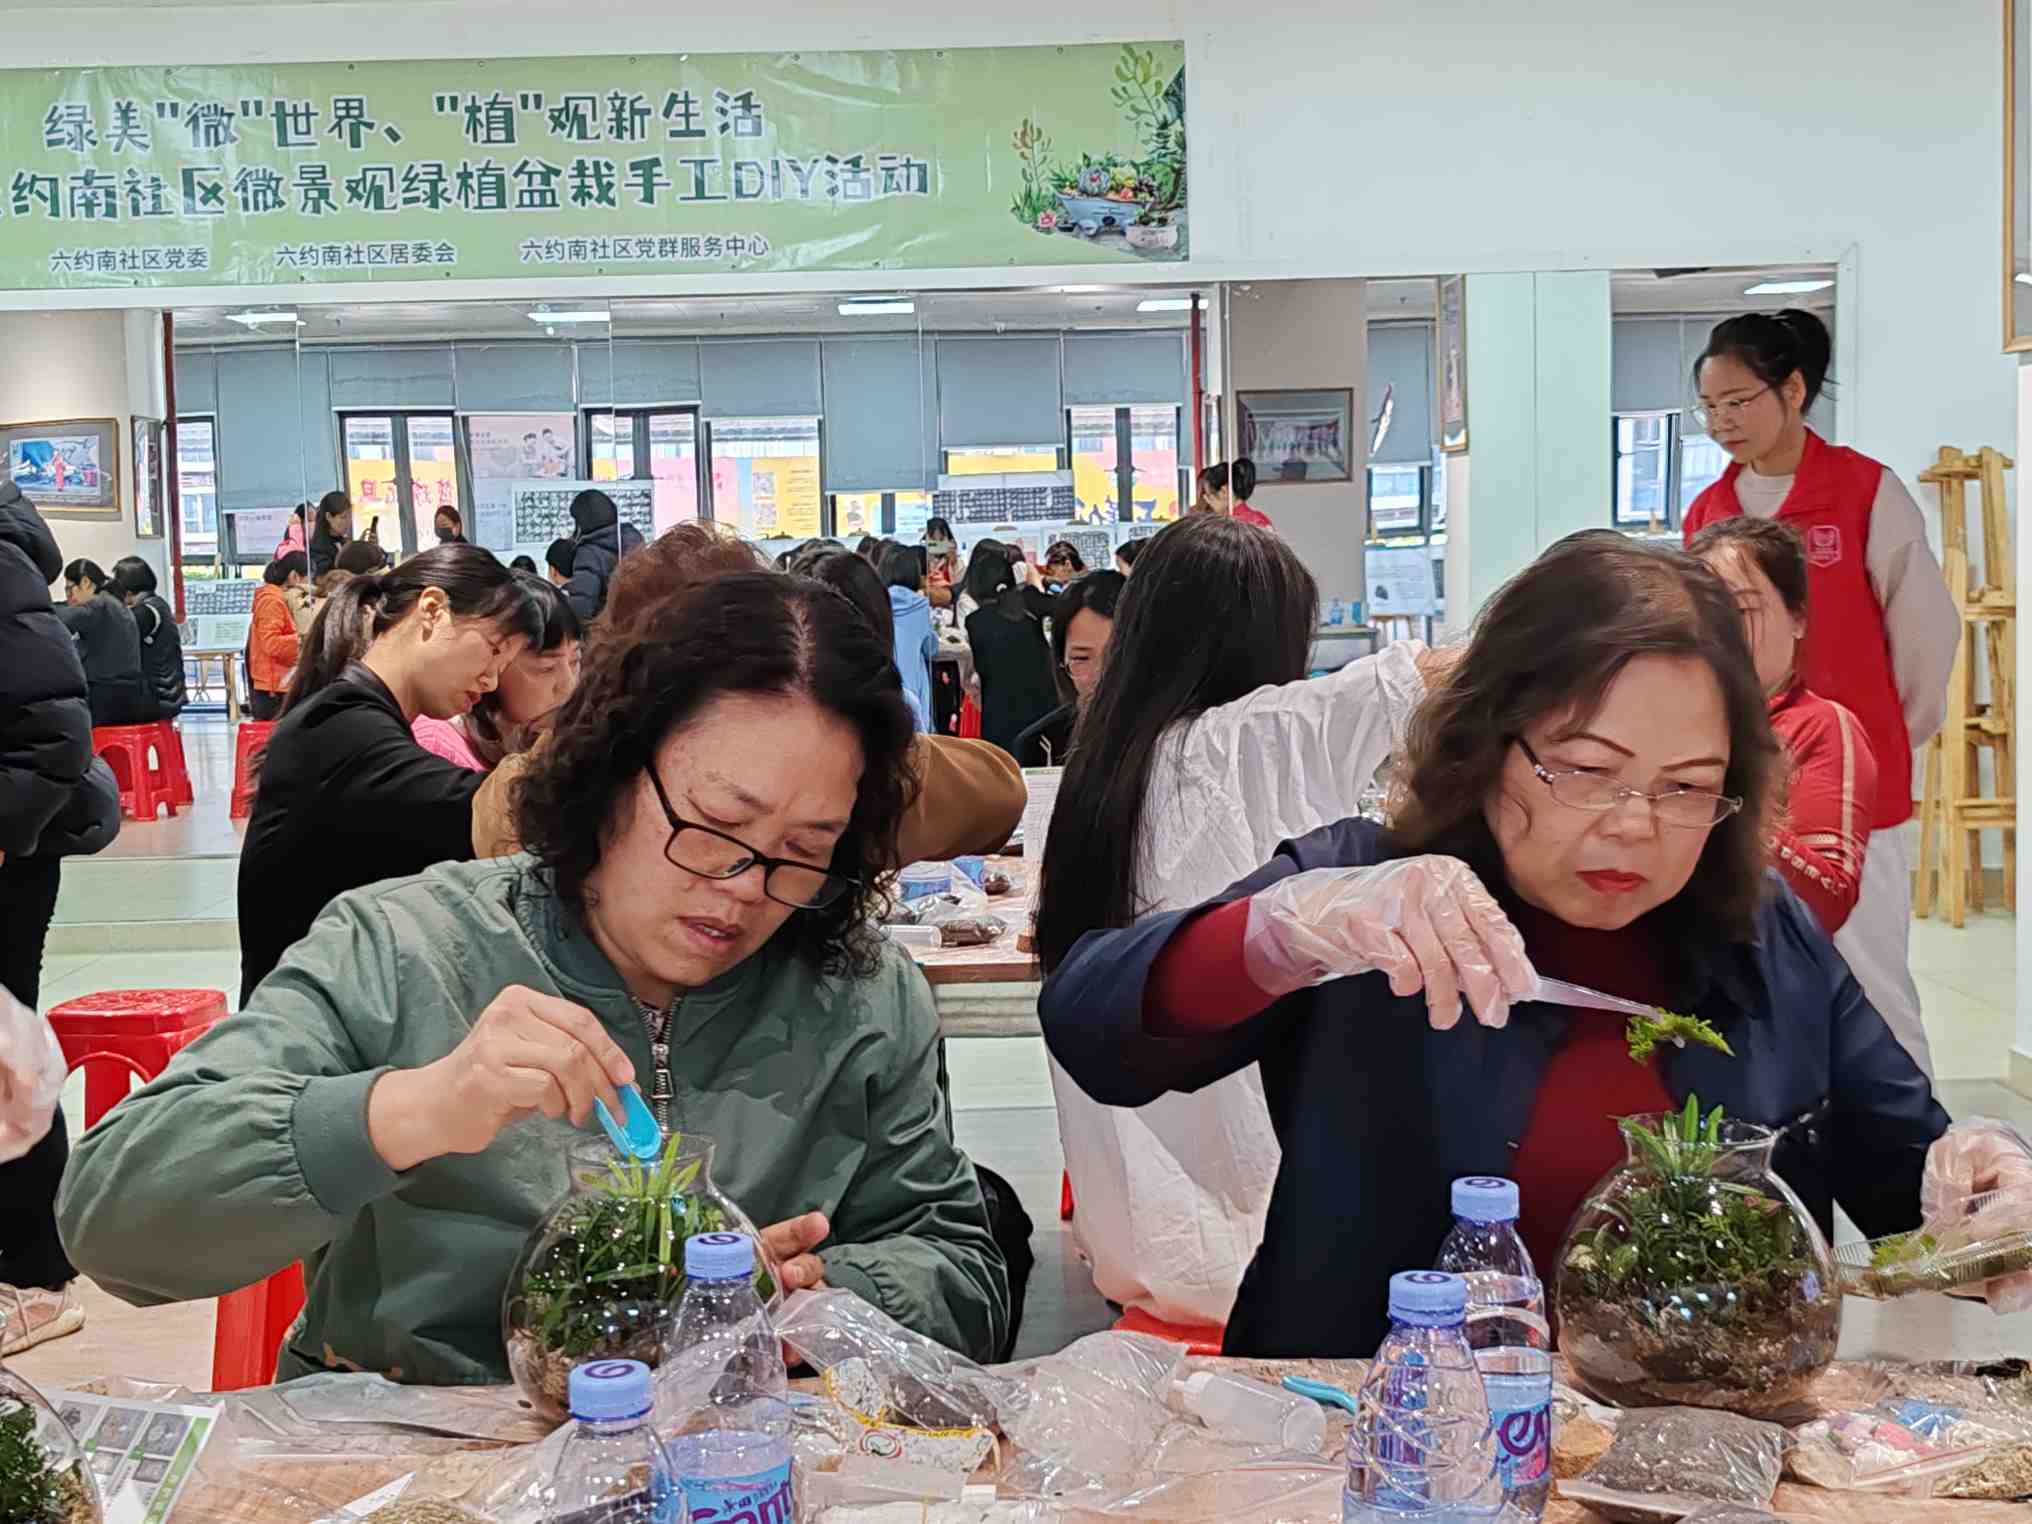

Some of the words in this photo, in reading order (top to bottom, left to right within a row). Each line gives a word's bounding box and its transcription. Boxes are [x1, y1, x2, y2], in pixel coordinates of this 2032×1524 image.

[0, 153, 929, 219] 约南社区微景观绿植盆栽手工DIY活动
[51, 248, 208, 272] 六约南社区党委
[276, 242, 456, 266] 六约南社区居委会
[521, 235, 769, 262] 六约南社区党群服务中心
